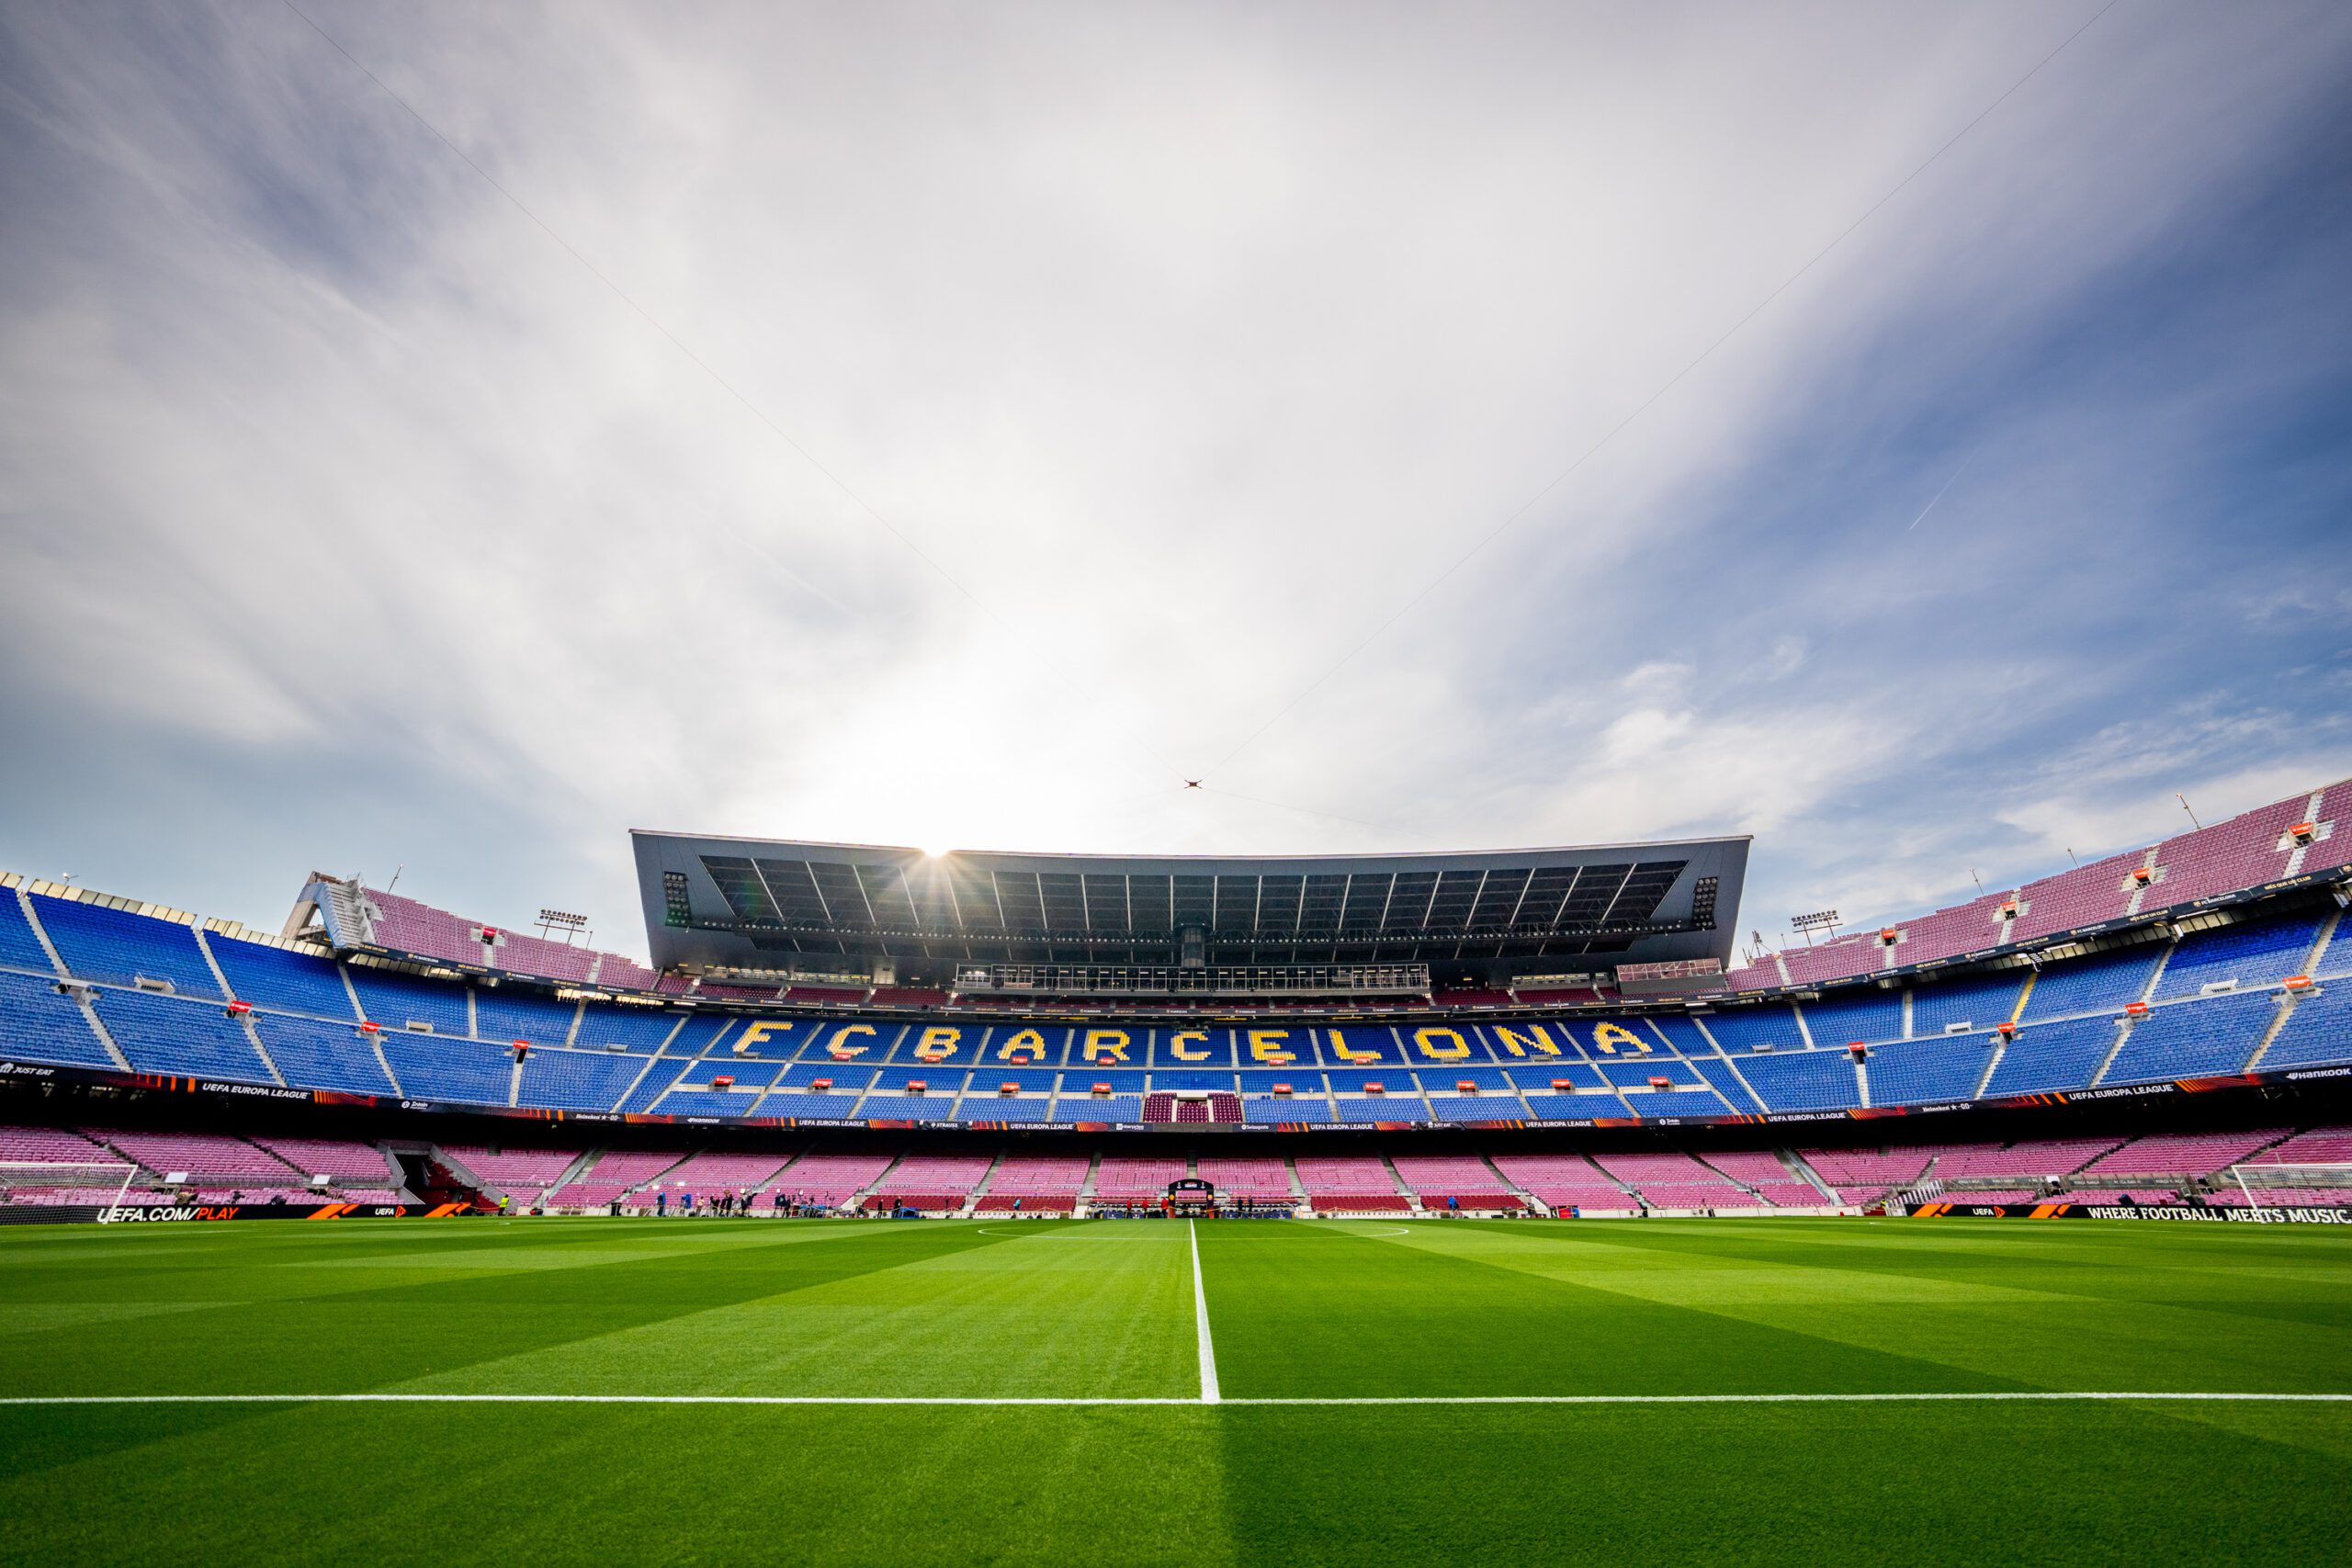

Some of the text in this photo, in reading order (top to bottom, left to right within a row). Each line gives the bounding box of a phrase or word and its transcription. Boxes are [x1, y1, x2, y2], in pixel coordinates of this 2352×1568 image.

[914, 1021, 1653, 1062] BARCELONA
[15, 1066, 55, 1077] JUST EAT
[202, 1083, 308, 1100] UEFA EUROPA LEAGUE
[2068, 1084, 2175, 1100] UEFA EUROPA LEAGUE
[375, 1208, 394, 1216] UEFA
[1972, 1208, 1995, 1216] UEFA
[2086, 1207, 2352, 1224] WHERE FOOTBALL MEETS MUSIC
